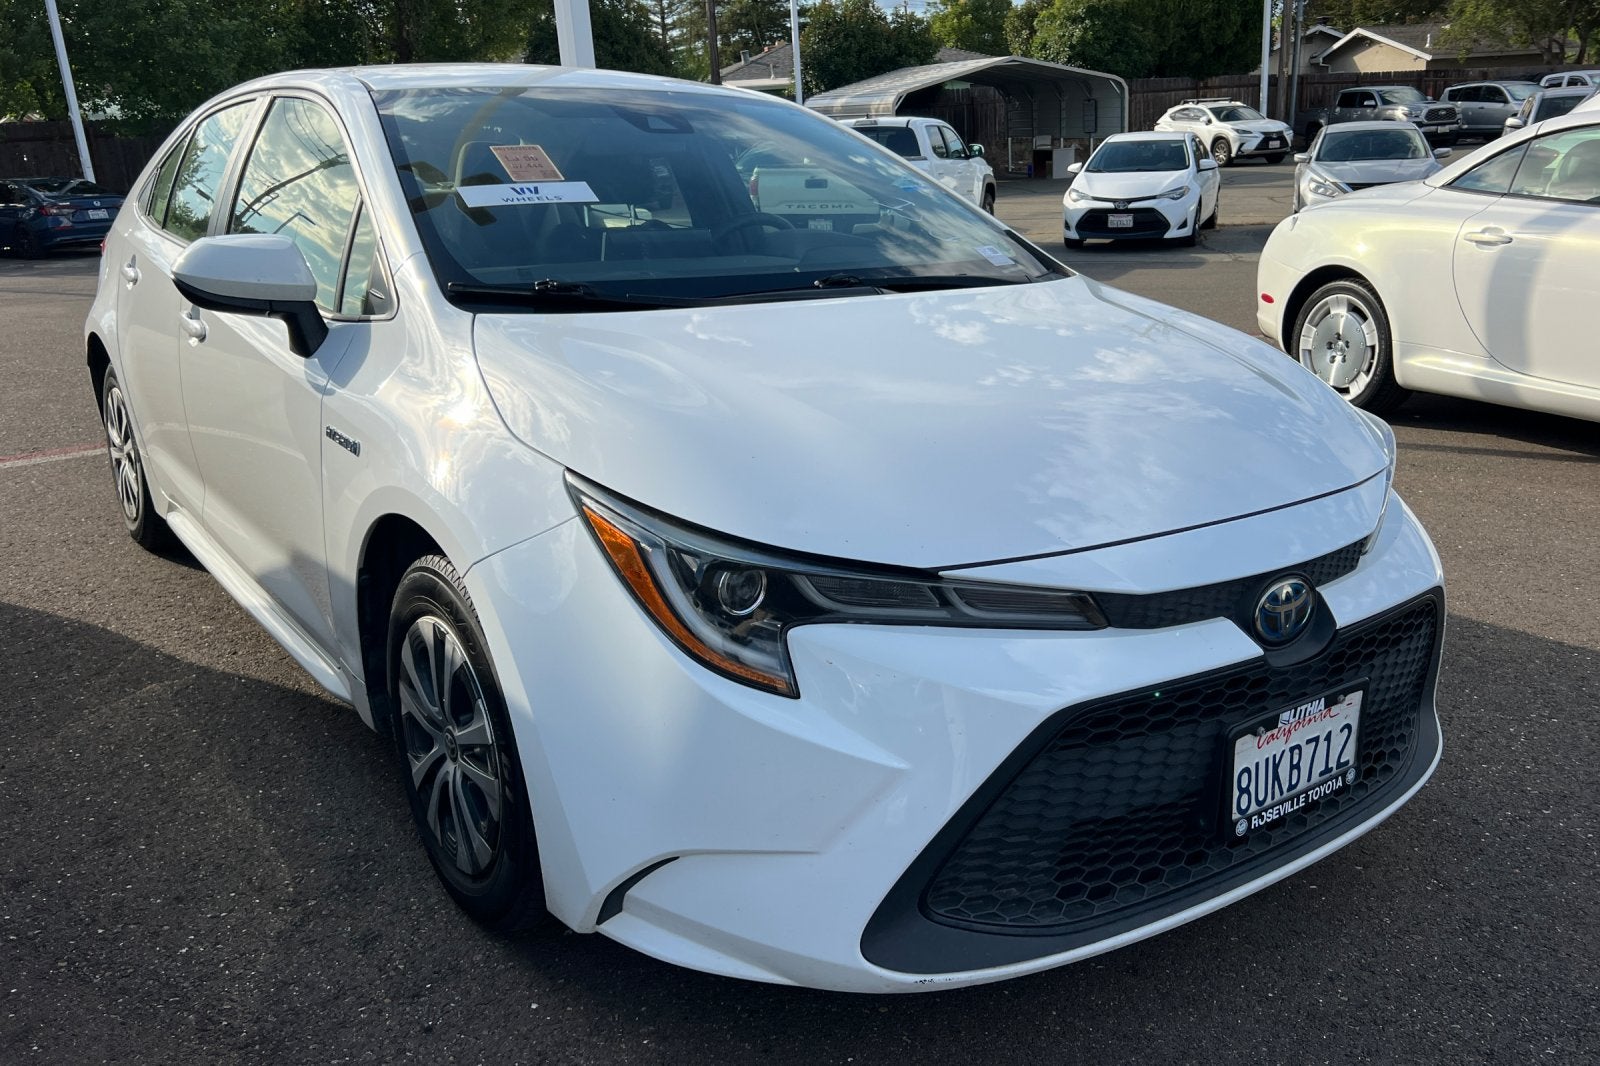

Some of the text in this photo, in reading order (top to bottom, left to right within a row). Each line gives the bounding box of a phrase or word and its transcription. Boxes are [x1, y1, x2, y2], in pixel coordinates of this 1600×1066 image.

[1257, 707, 1340, 750] California
[1289, 697, 1326, 724] LITHIA
[1236, 723, 1353, 815] 8UKB712
[1251, 776, 1343, 829] ROSEVILLE TOYOTA
